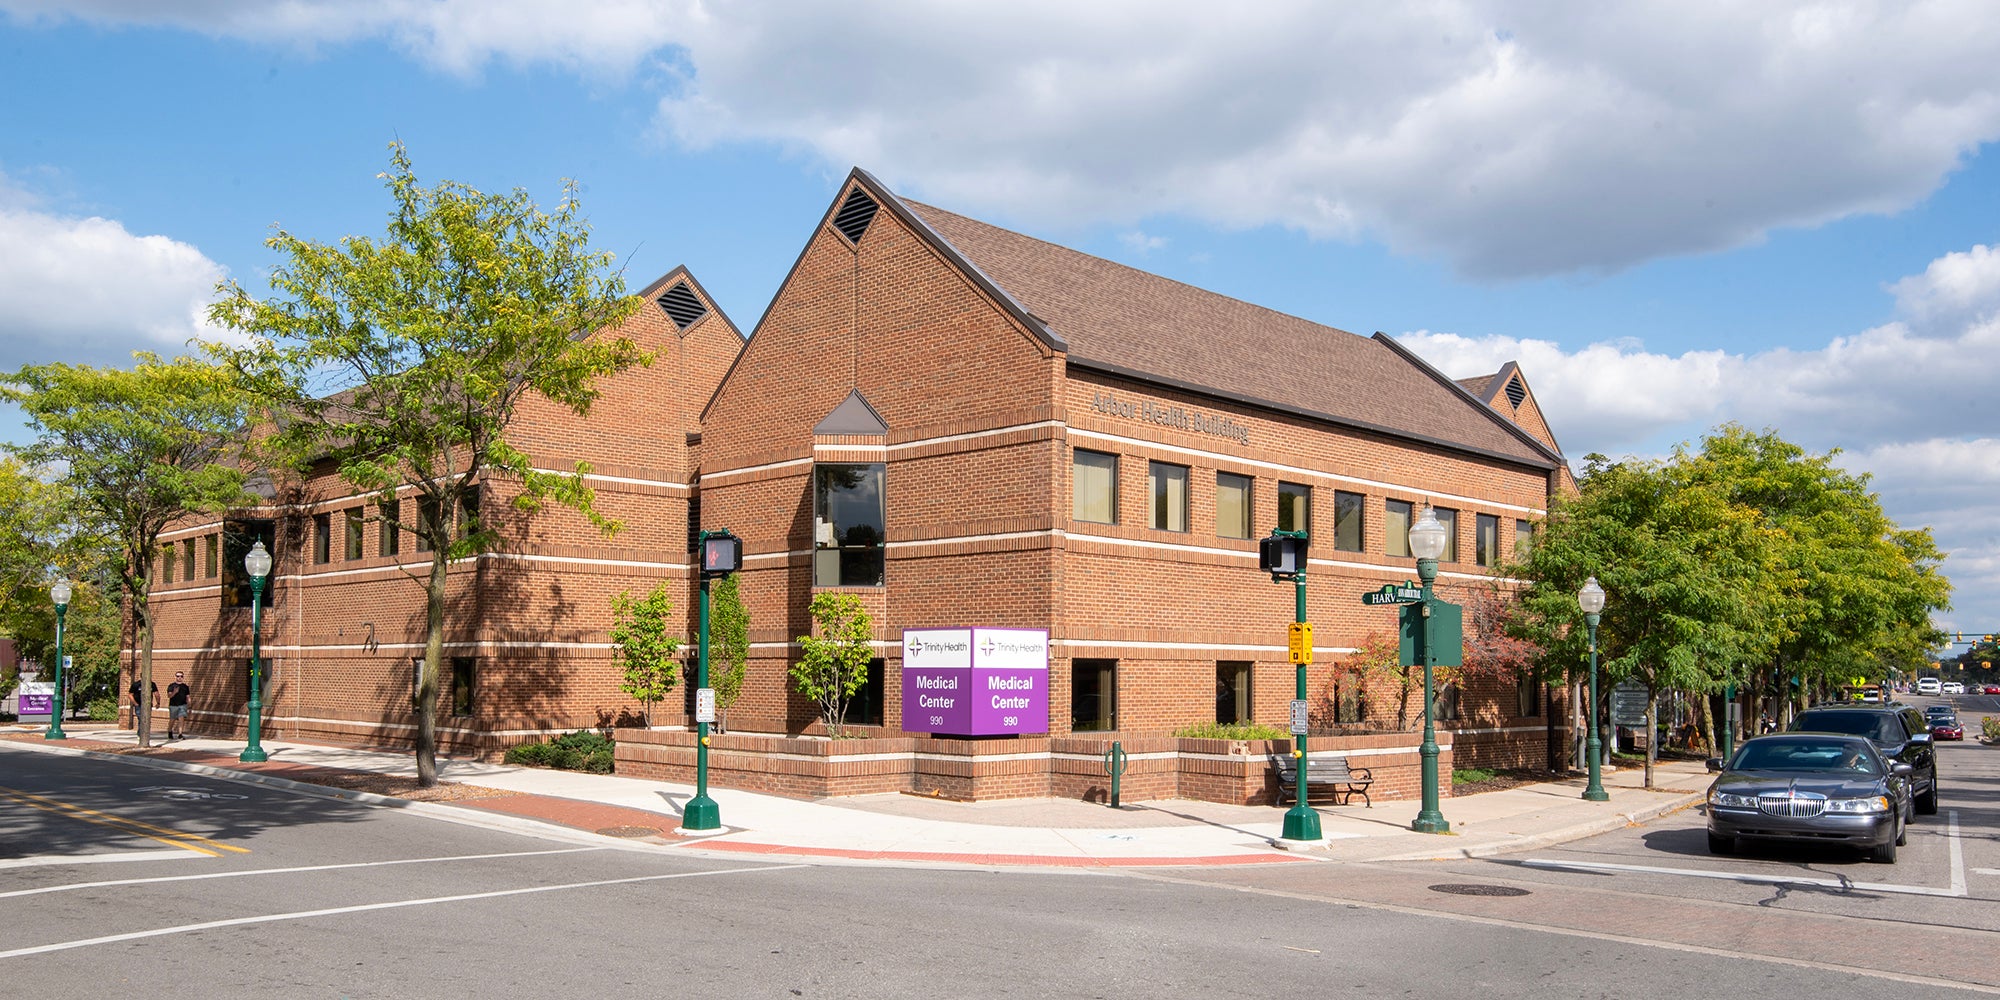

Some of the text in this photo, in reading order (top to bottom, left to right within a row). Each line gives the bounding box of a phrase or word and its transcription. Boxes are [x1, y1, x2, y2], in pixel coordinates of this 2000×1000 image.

[1090, 391, 1250, 446] Arbor Health Building
[1372, 593, 1406, 604] HARV
[924, 642, 967, 654] Trinity Health
[997, 642, 1043, 654] Trinity Health
[916, 675, 958, 690] Medical
[988, 675, 1033, 690] Medical
[919, 694, 955, 709] Center
[991, 695, 1030, 709] Center
[929, 715, 943, 726] 990
[1003, 716, 1018, 726] 990
